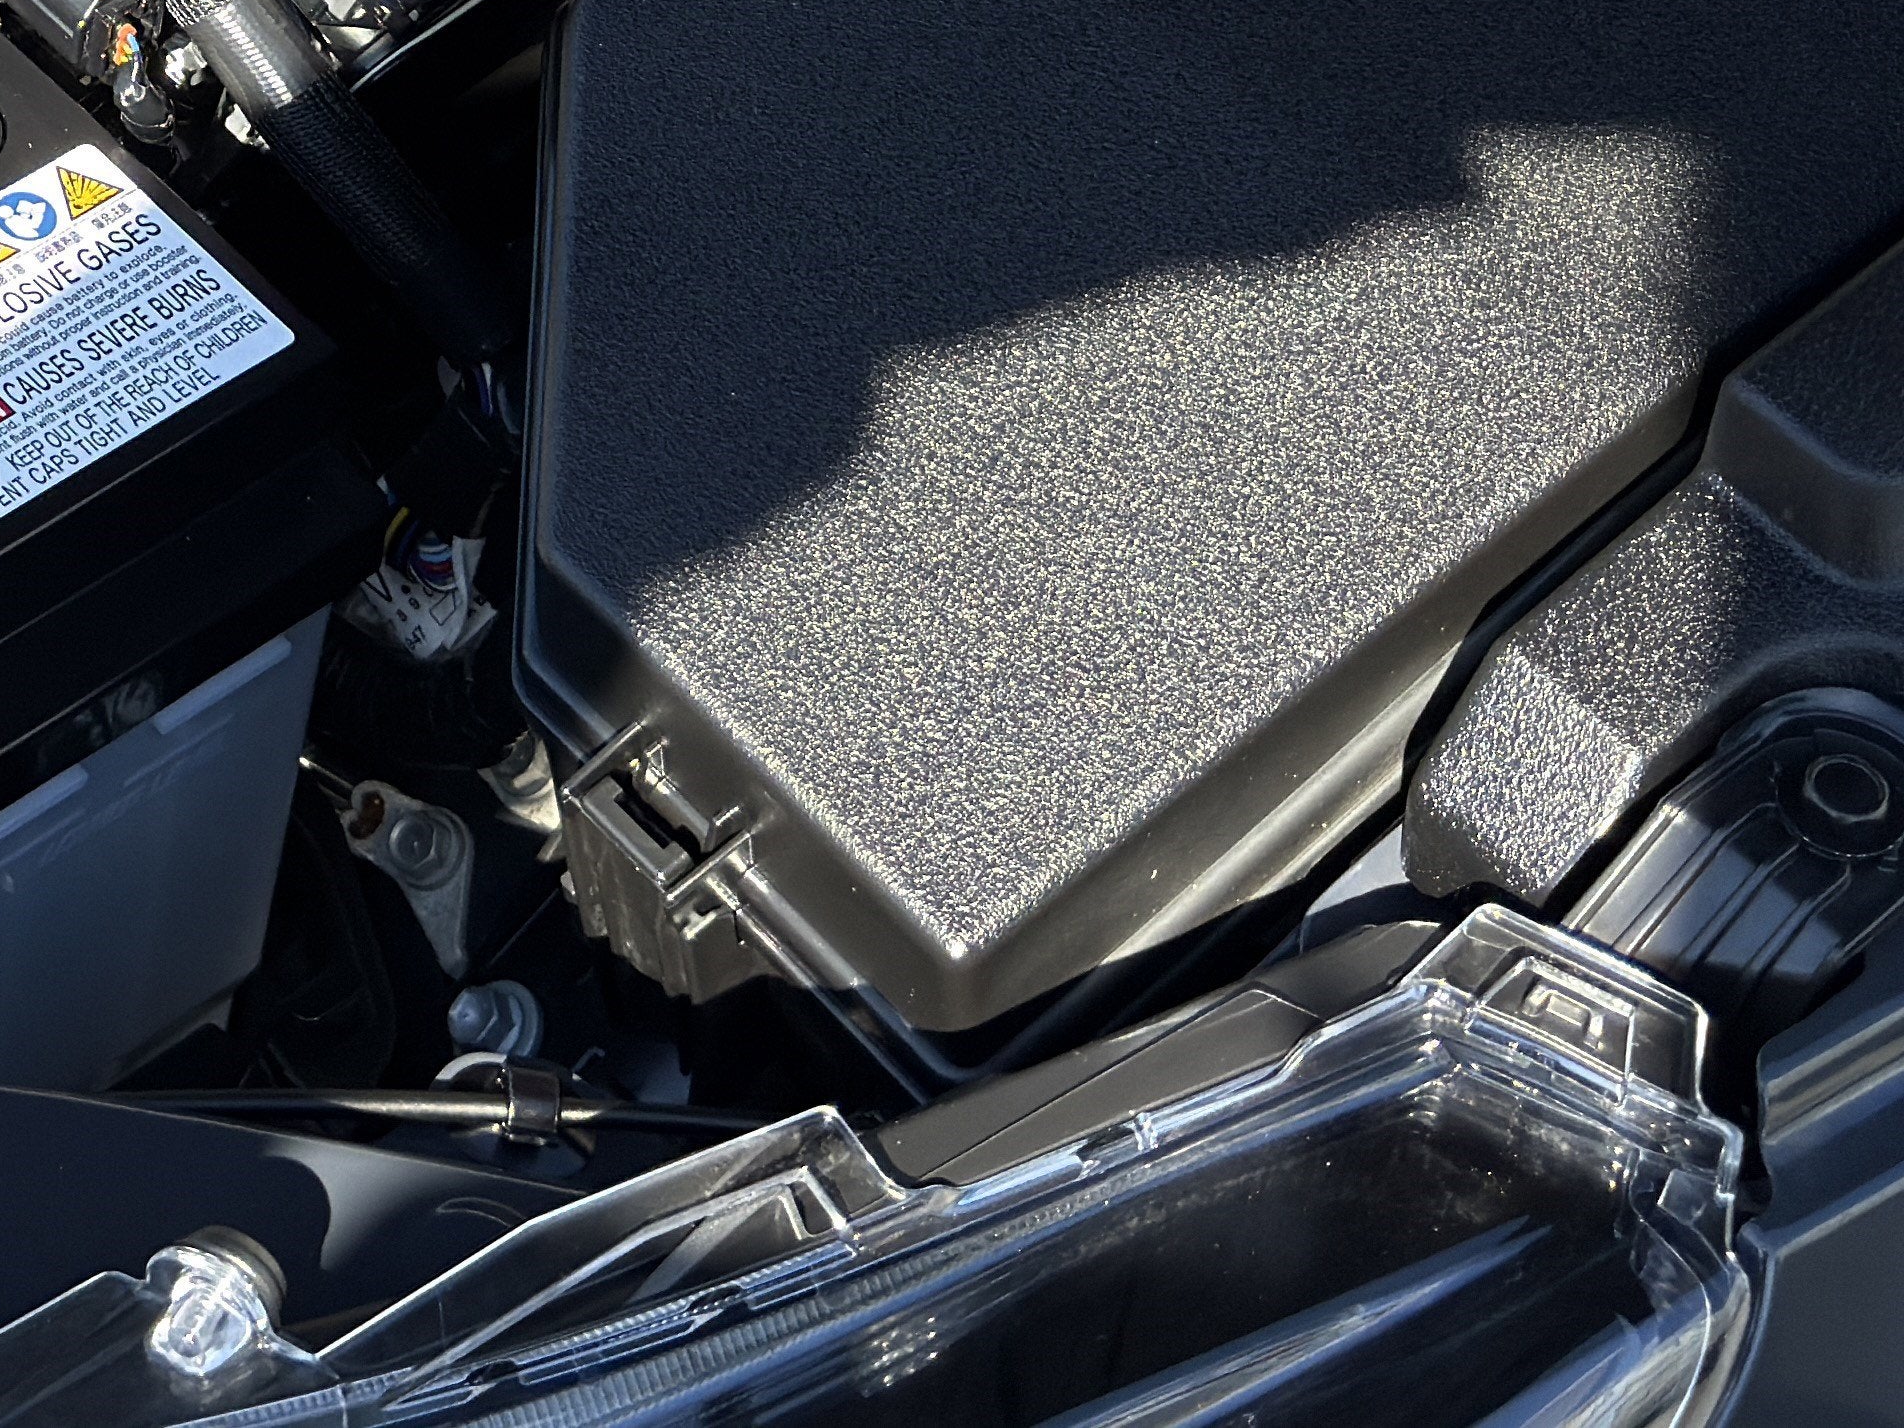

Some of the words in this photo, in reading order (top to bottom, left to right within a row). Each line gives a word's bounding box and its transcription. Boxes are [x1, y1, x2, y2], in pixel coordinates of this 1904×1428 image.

[28, 301, 65, 326] cause
[61, 277, 106, 306] battery
[102, 270, 119, 282] to
[118, 244, 167, 274] explode.
[46, 315, 67, 330] Do
[63, 304, 86, 321] not
[82, 285, 120, 311] charge
[116, 277, 131, 290] or
[128, 267, 151, 284] use
[145, 243, 188, 272] booster
[75, 212, 162, 271] GASES
[1, 347, 85, 405] CAUSES
[75, 304, 158, 361] SEVERE
[146, 267, 221, 321] BURNS
[21, 334, 61, 361] without
[57, 315, 93, 342] proper
[88, 286, 144, 321] instruction
[140, 273, 164, 292] and
[3, 438, 45, 472] KEEP
[42, 418, 79, 448] OUT
[73, 406, 98, 430] OF
[92, 389, 132, 418] THE
[121, 360, 180, 402] REACH
[172, 348, 197, 372] OF
[192, 308, 268, 359] CHILDREN
[8, 424, 38, 445] flush
[35, 410, 61, 429] with
[56, 392, 89, 416] water
[87, 379, 112, 398] and
[108, 367, 131, 386] call
[127, 363, 140, 374] a
[136, 336, 187, 370] physician
[20, 396, 55, 423] Avoid
[52, 371, 98, 402] contact
[95, 358, 122, 377] with
[147, 326, 176, 347] eyes
[174, 318, 190, 331] or
[27, 447, 80, 485] CAPS
[72, 416, 128, 456] TIGHT
[126, 395, 167, 428] AND
[160, 365, 221, 404] LEVEL
